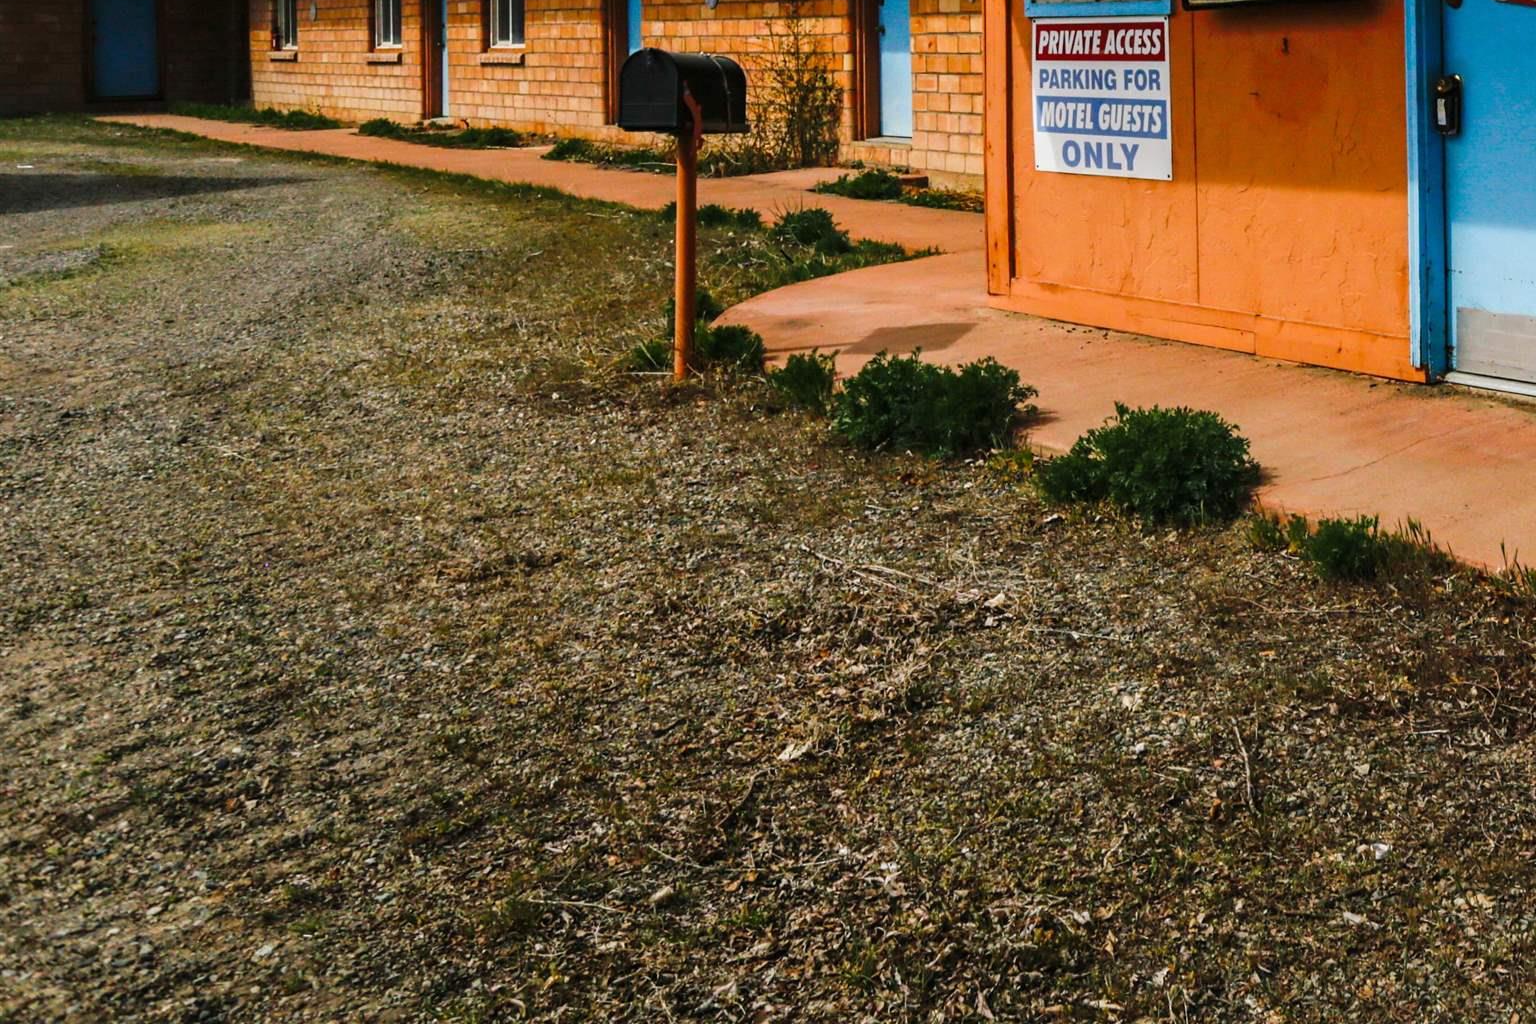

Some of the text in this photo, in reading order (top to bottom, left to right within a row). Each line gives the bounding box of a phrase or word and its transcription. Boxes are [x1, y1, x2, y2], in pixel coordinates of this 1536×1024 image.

[1038, 28, 1162, 55] PRIVATE ACCESS
[1039, 68, 1161, 91] PARKING FOR
[1040, 101, 1162, 134] MOTEL GUESTS
[1061, 139, 1139, 171] ONLY
